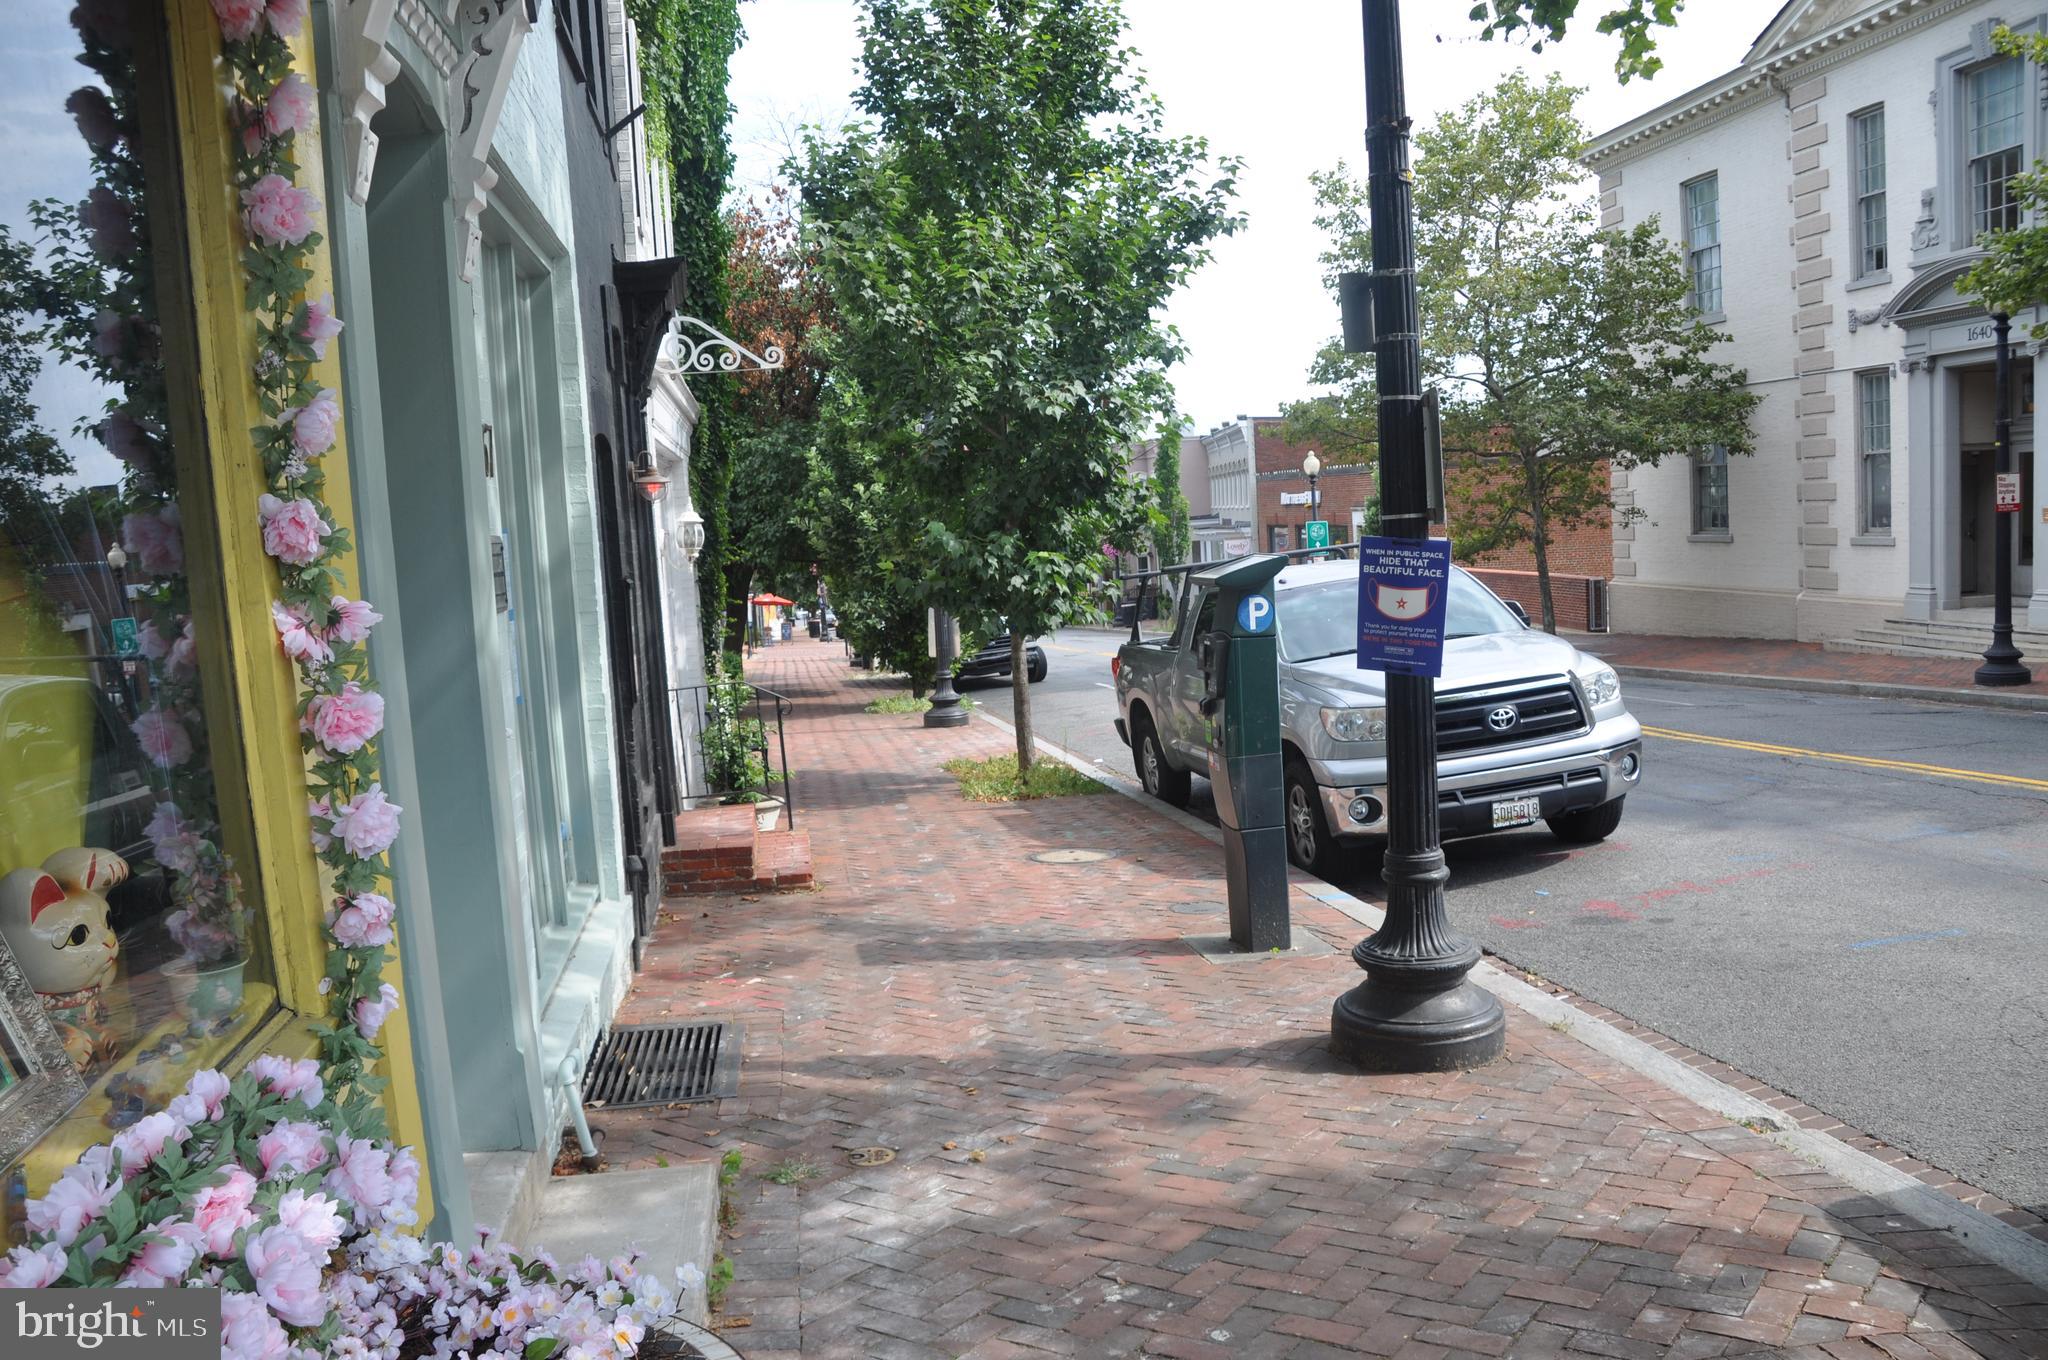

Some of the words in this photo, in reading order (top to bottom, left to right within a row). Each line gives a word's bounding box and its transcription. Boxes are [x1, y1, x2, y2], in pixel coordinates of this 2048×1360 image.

[1968, 325, 1992, 341] 1640
[1380, 557, 1400, 565] HIDE
[1404, 558, 1429, 567] THAT
[1364, 565, 1415, 576] BEAUTIFUL
[1418, 568, 1444, 578] FACE.
[1249, 597, 1270, 630] P
